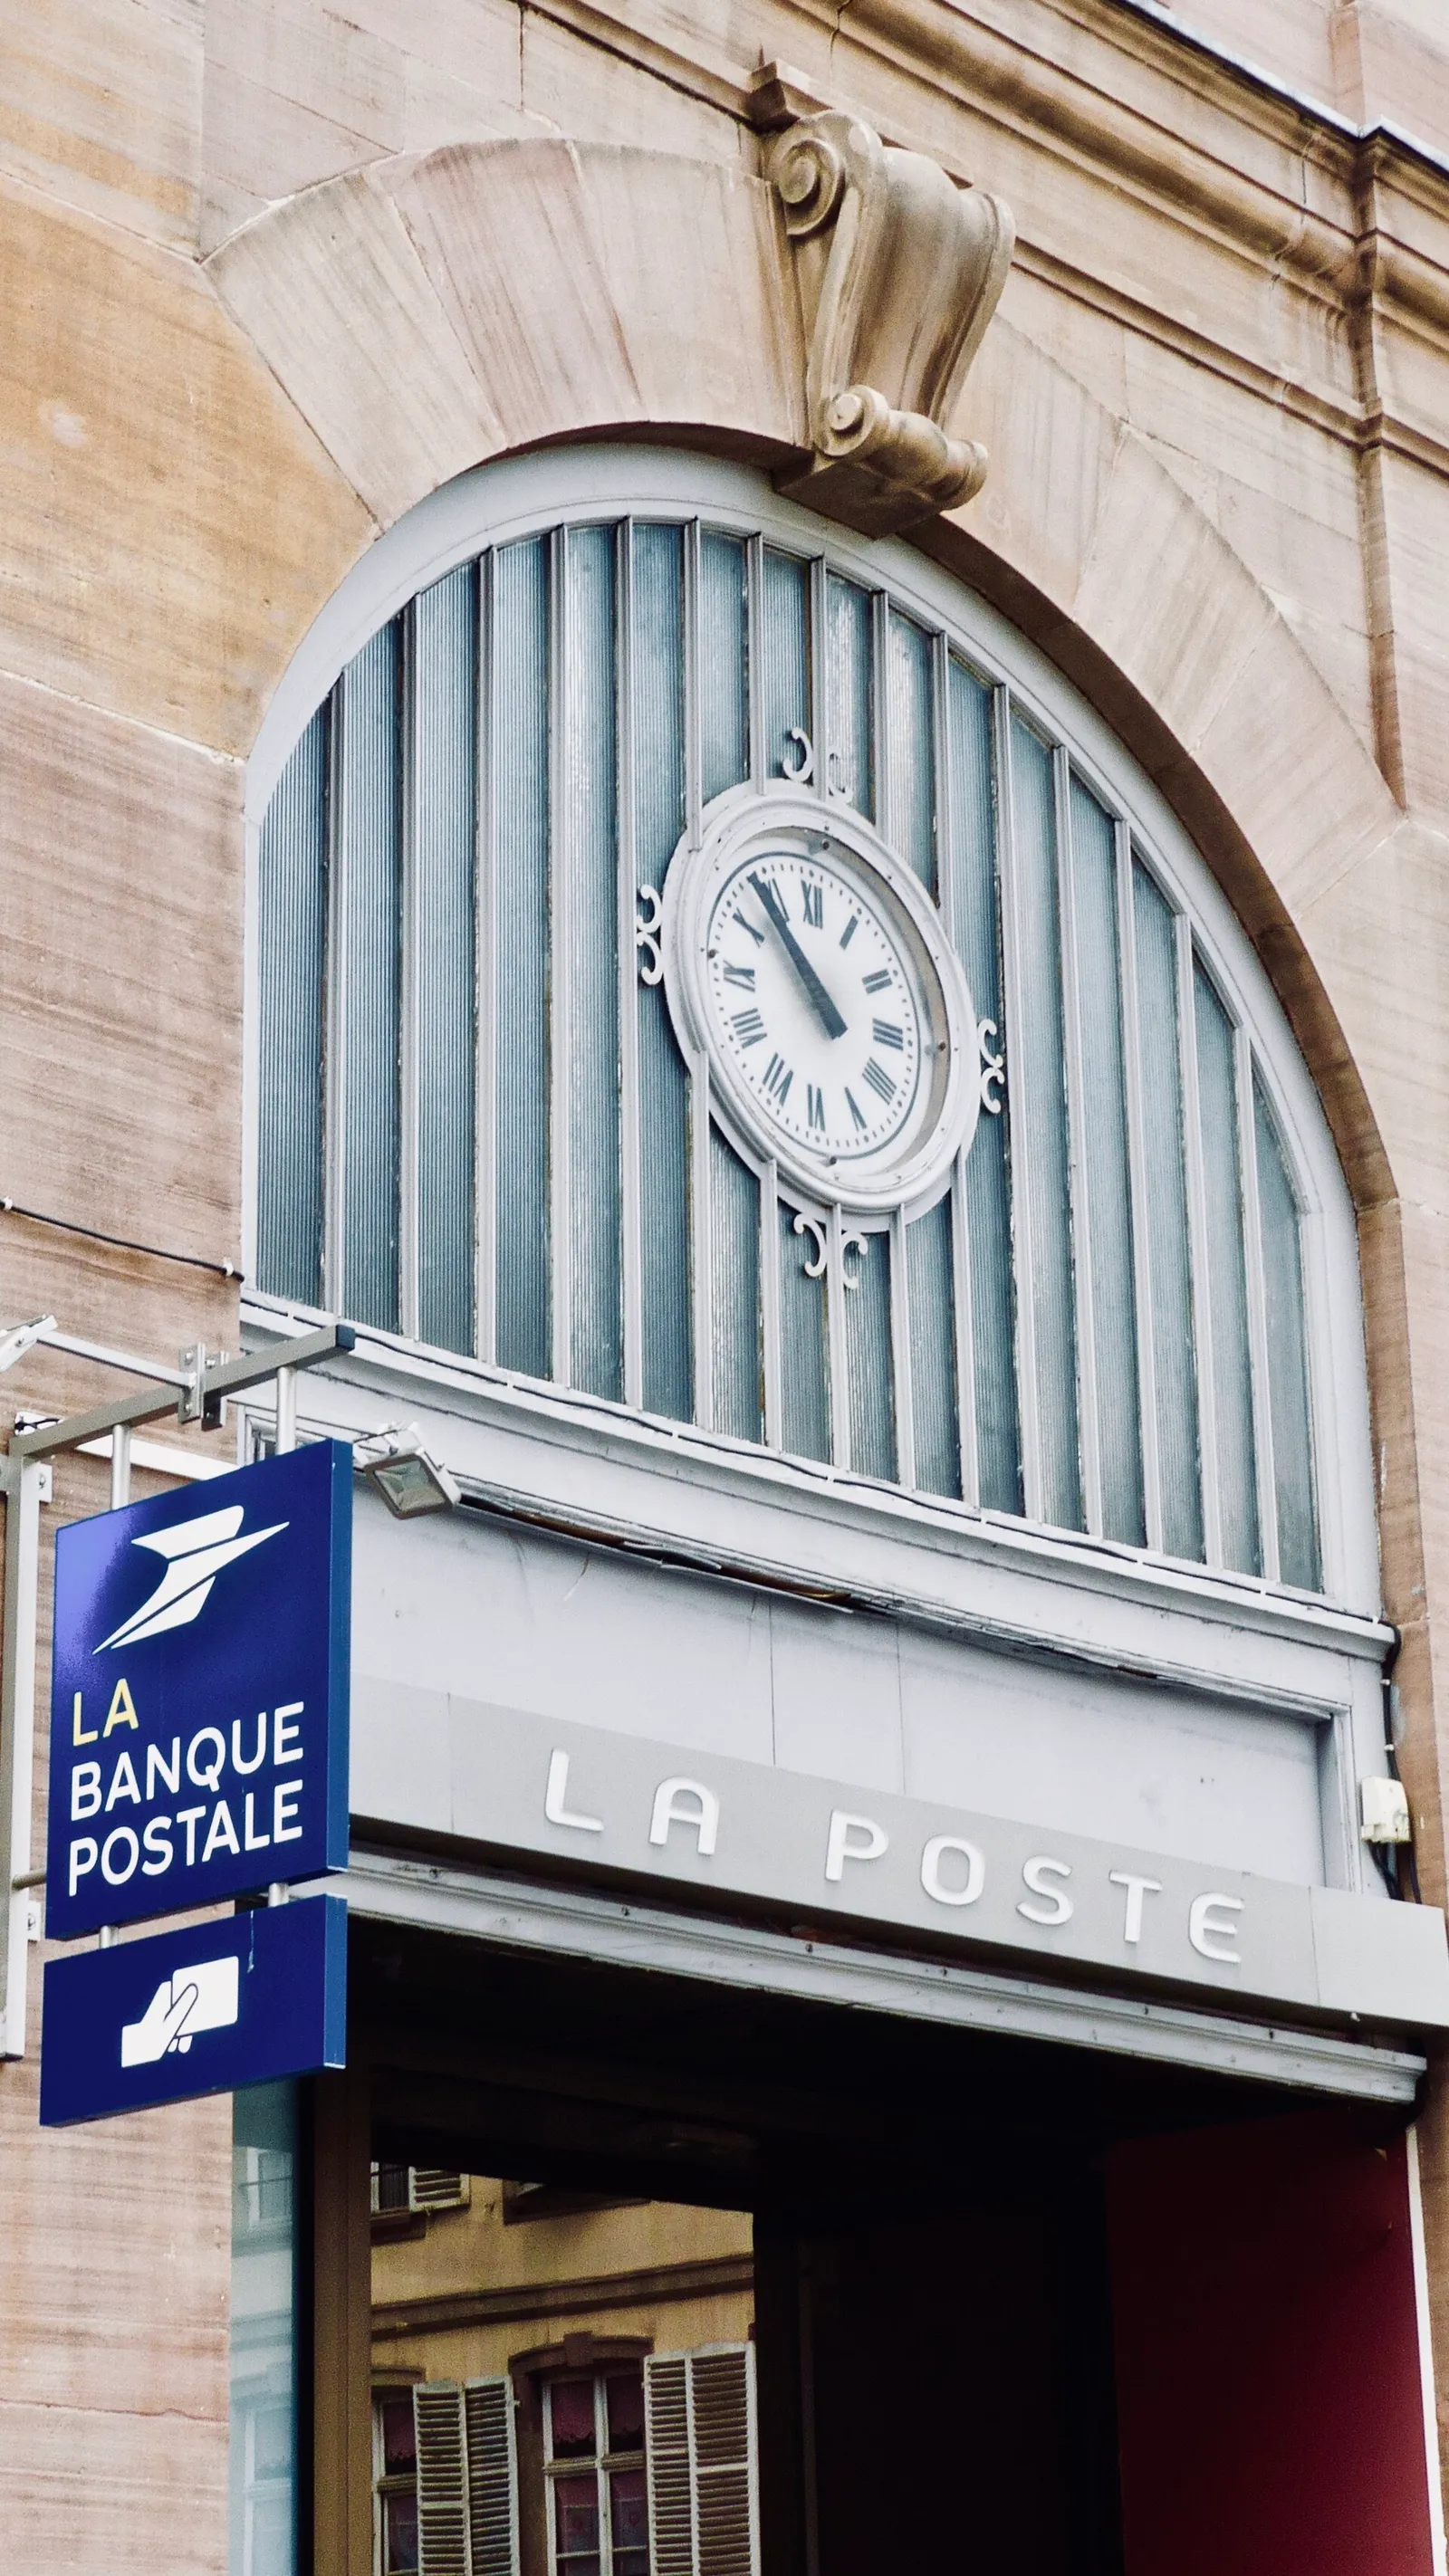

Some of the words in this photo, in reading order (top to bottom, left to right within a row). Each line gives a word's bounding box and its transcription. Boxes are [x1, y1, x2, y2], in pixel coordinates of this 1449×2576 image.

[732, 906, 765, 949] X
[801, 879, 824, 931] XII
[839, 915, 859, 951] I
[723, 959, 756, 993] IX
[861, 968, 893, 995] II
[730, 1007, 768, 1049] VIII
[872, 1017, 905, 1052] III
[762, 1051, 794, 1107] VII
[807, 1082, 826, 1133] VI
[844, 1086, 868, 1133] V
[72, 1678, 139, 1747] LA
[71, 1701, 304, 1822] BANQUE
[69, 1779, 303, 1897] POSTALE
[544, 1748, 721, 1856] LA
[825, 1809, 1246, 1964] POSTE
